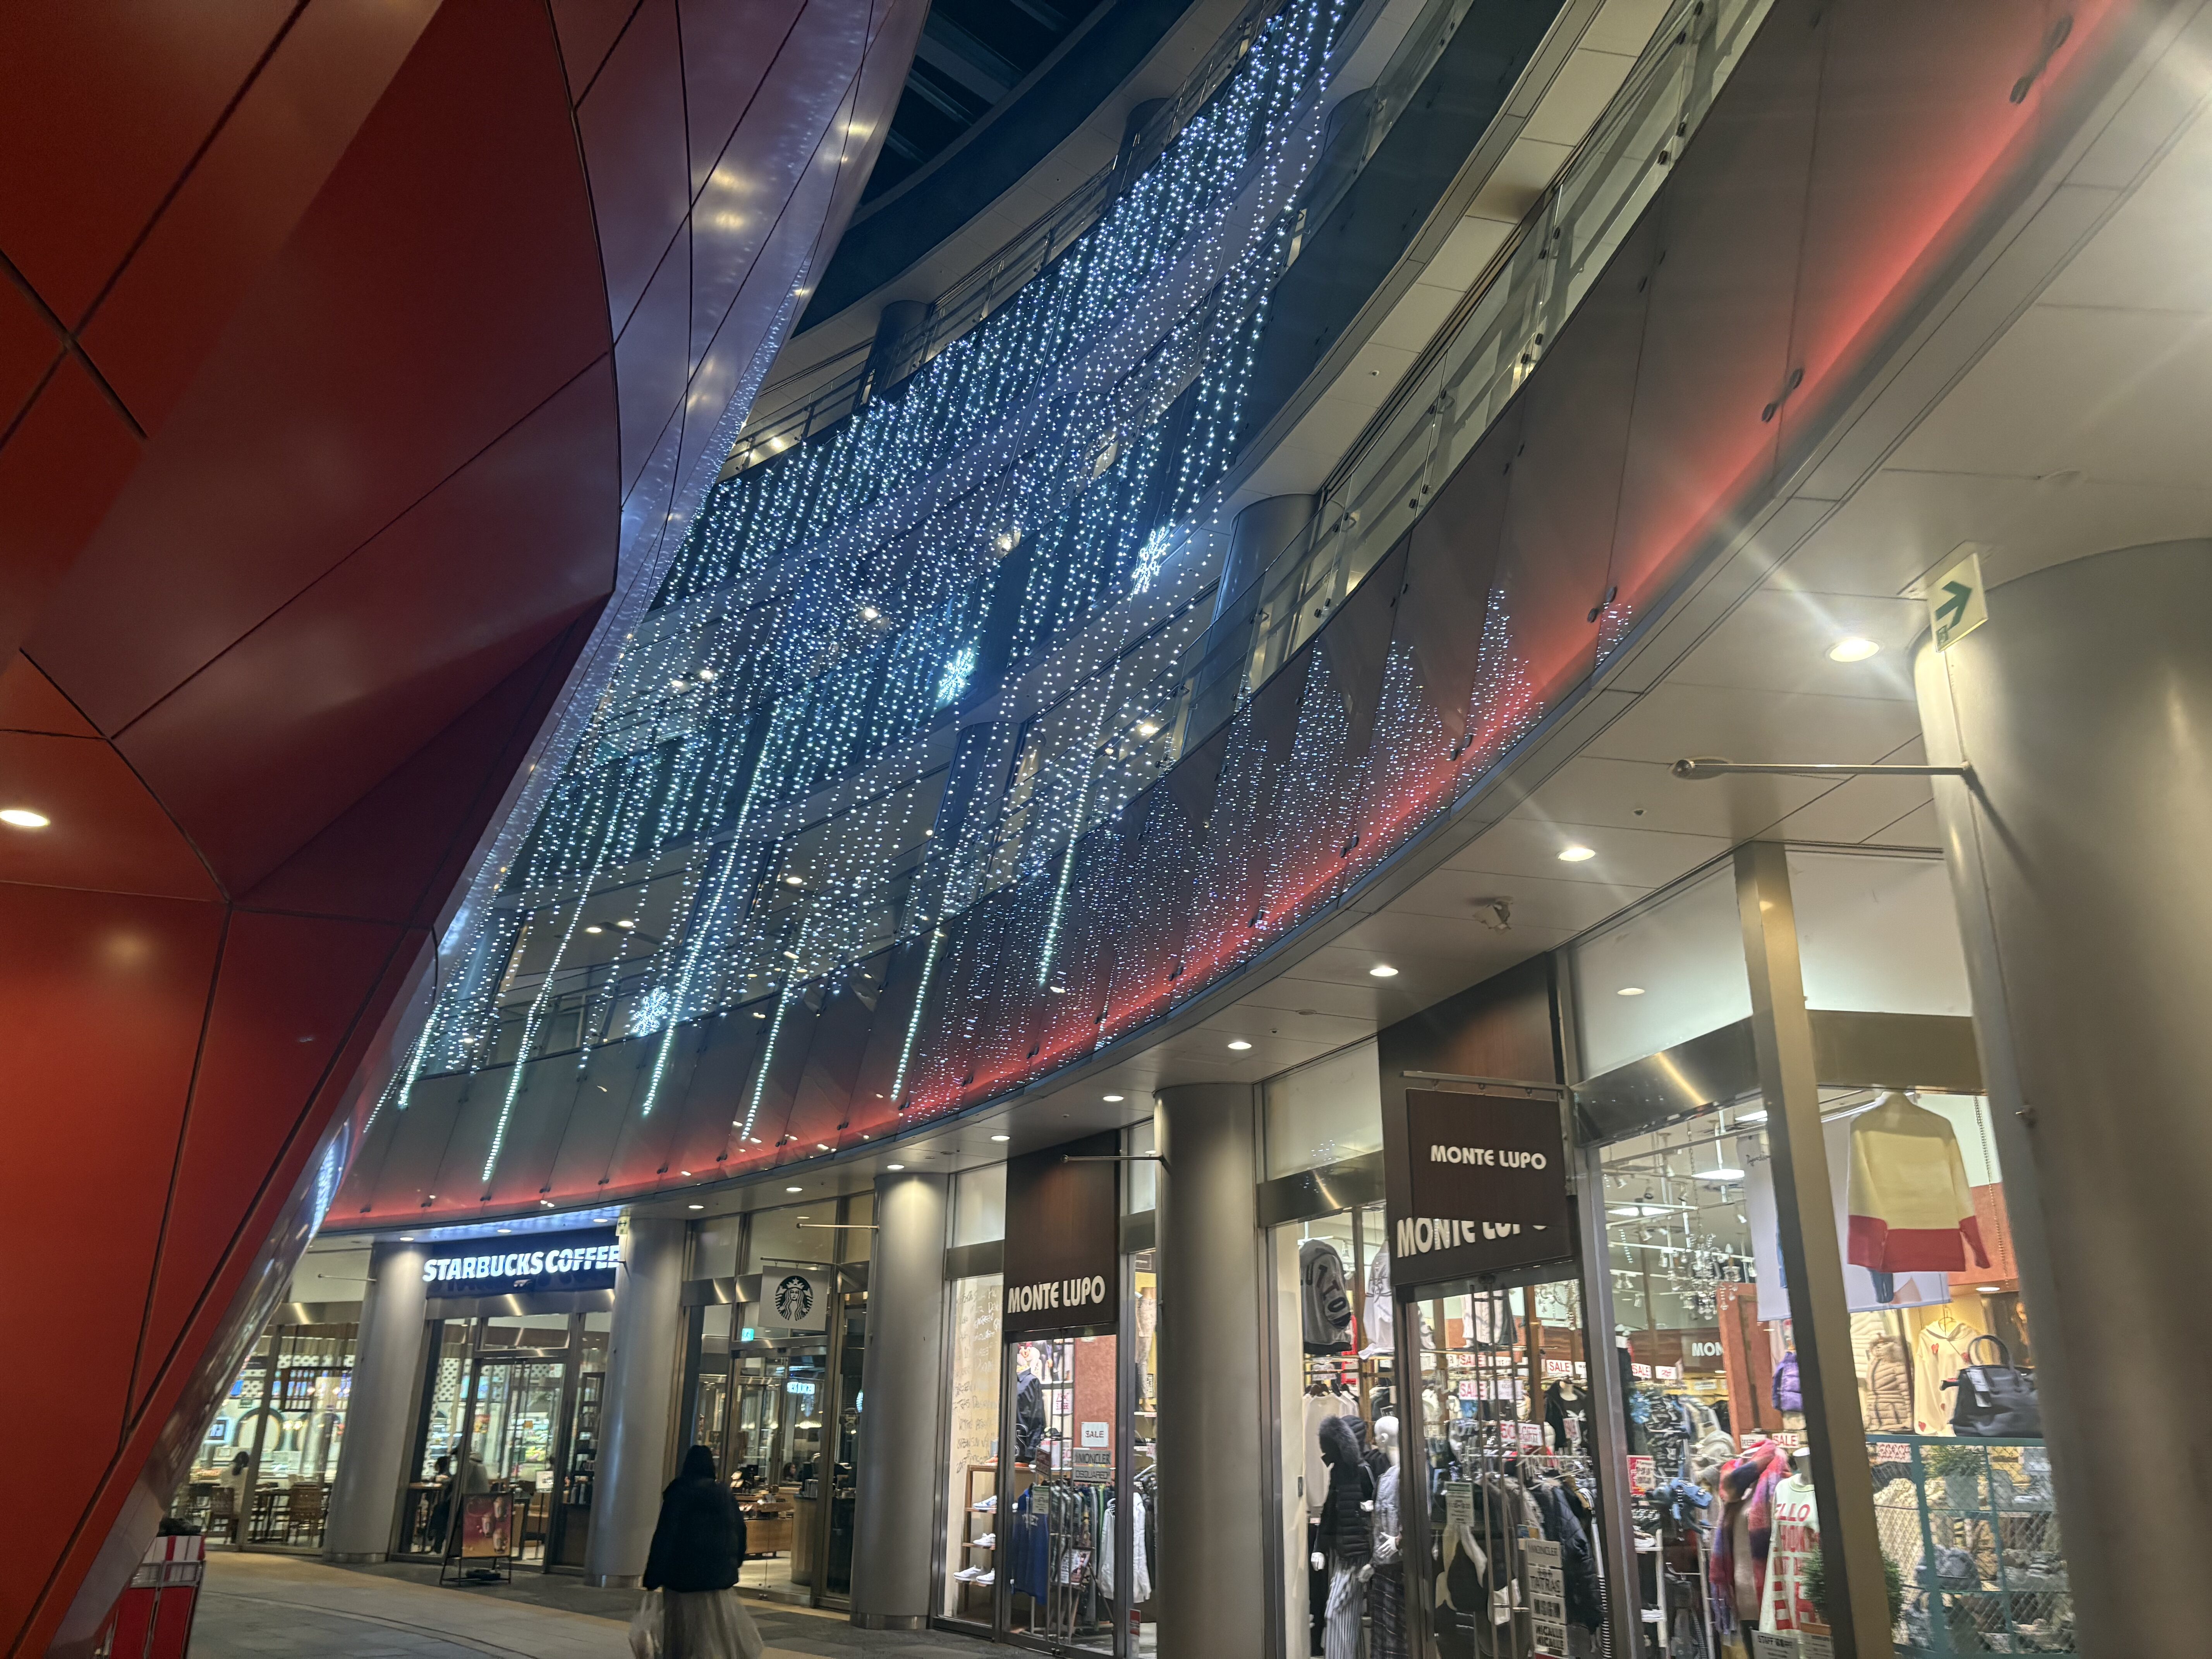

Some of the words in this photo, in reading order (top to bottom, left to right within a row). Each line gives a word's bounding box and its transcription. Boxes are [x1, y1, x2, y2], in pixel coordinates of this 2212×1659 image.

[1431, 1145, 1494, 1166] MONTE
[1499, 1150, 1547, 1170] LUPO
[422, 1252, 544, 1282] STARBUCKS
[545, 1245, 620, 1273] COFFEE
[1008, 1281, 1059, 1314] MONTE
[1063, 1275, 1106, 1307] LUPO
[1549, 1361, 1570, 1372] SALE
[1632, 1365, 1651, 1376] SALE
[1460, 1383, 1485, 1398] SALE
[1773, 1435, 1797, 1446] SALE
